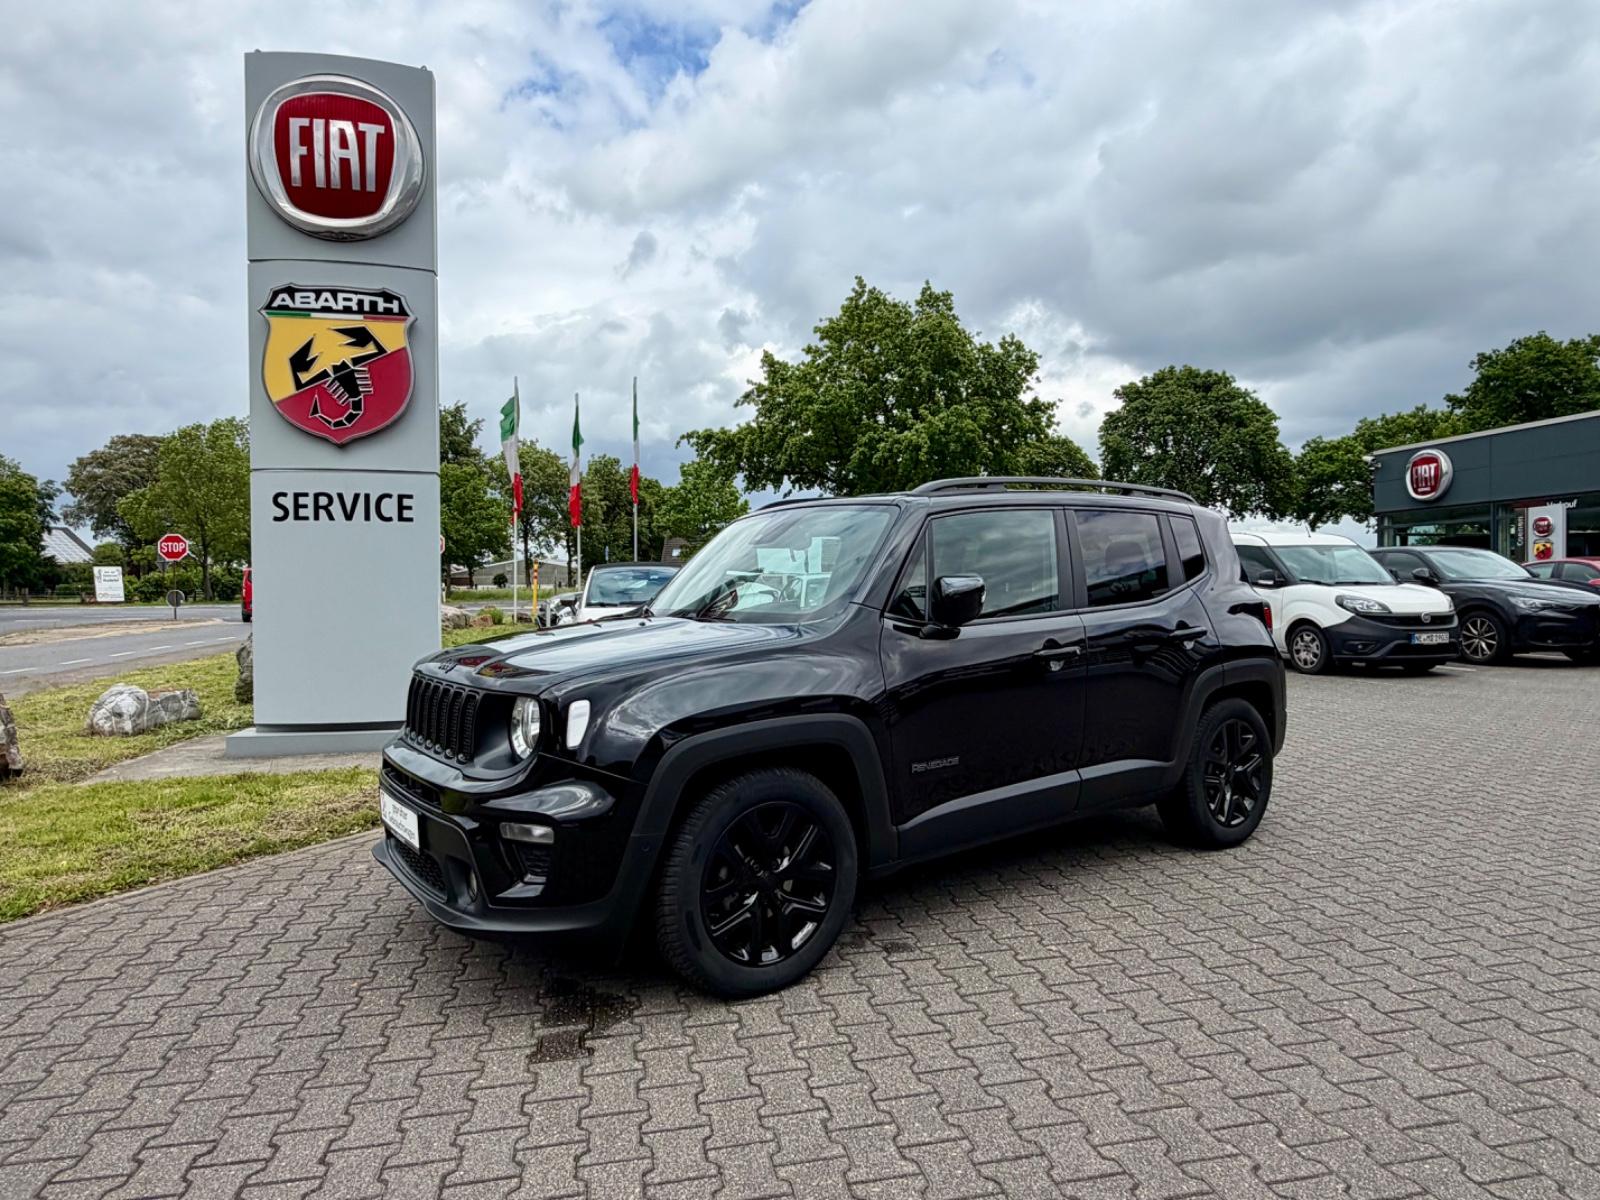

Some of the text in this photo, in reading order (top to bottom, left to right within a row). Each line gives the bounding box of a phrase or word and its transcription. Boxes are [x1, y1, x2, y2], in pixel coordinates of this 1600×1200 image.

[289, 117, 385, 192] FIAT
[271, 291, 399, 313] ABARTH
[1412, 463, 1438, 488] FIAT
[272, 491, 414, 523] SERVICE
[161, 542, 186, 553] STOP
[911, 755, 960, 774] RENEGADE
